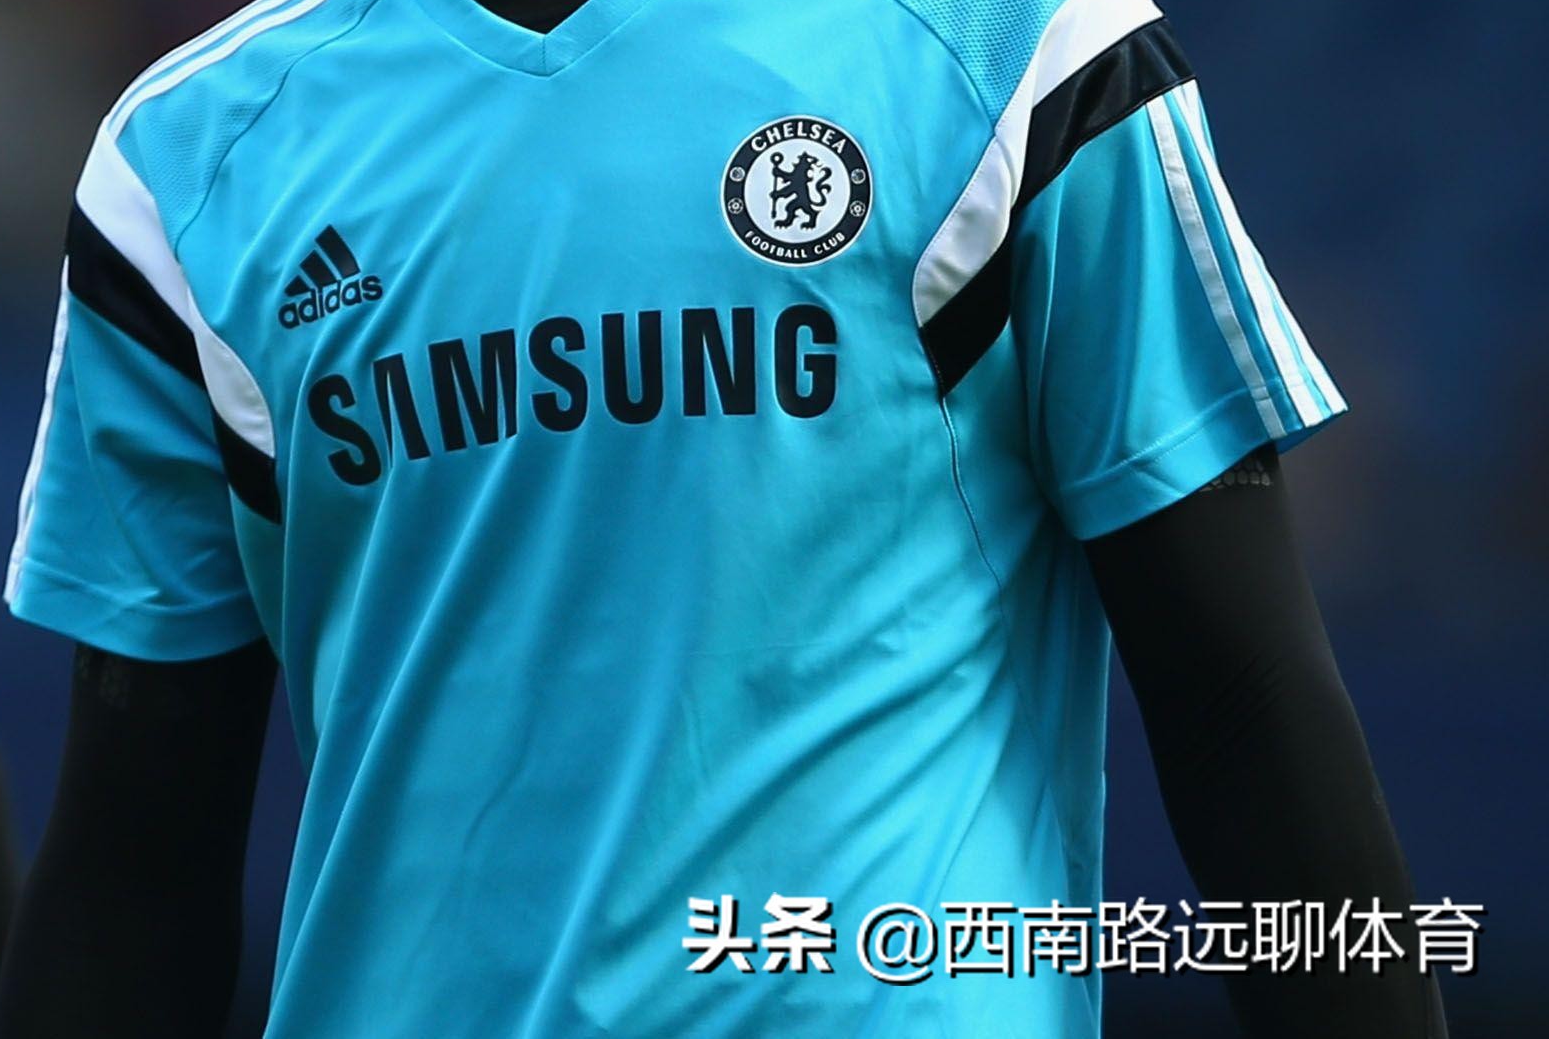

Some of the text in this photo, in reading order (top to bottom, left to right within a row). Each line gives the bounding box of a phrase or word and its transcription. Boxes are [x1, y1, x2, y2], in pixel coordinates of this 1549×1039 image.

[750, 121, 847, 153] CHELSEA
[744, 230, 846, 259] FOOTBALL CLUB
[278, 275, 383, 330] adidas
[307, 305, 839, 487] SAMSUNG
